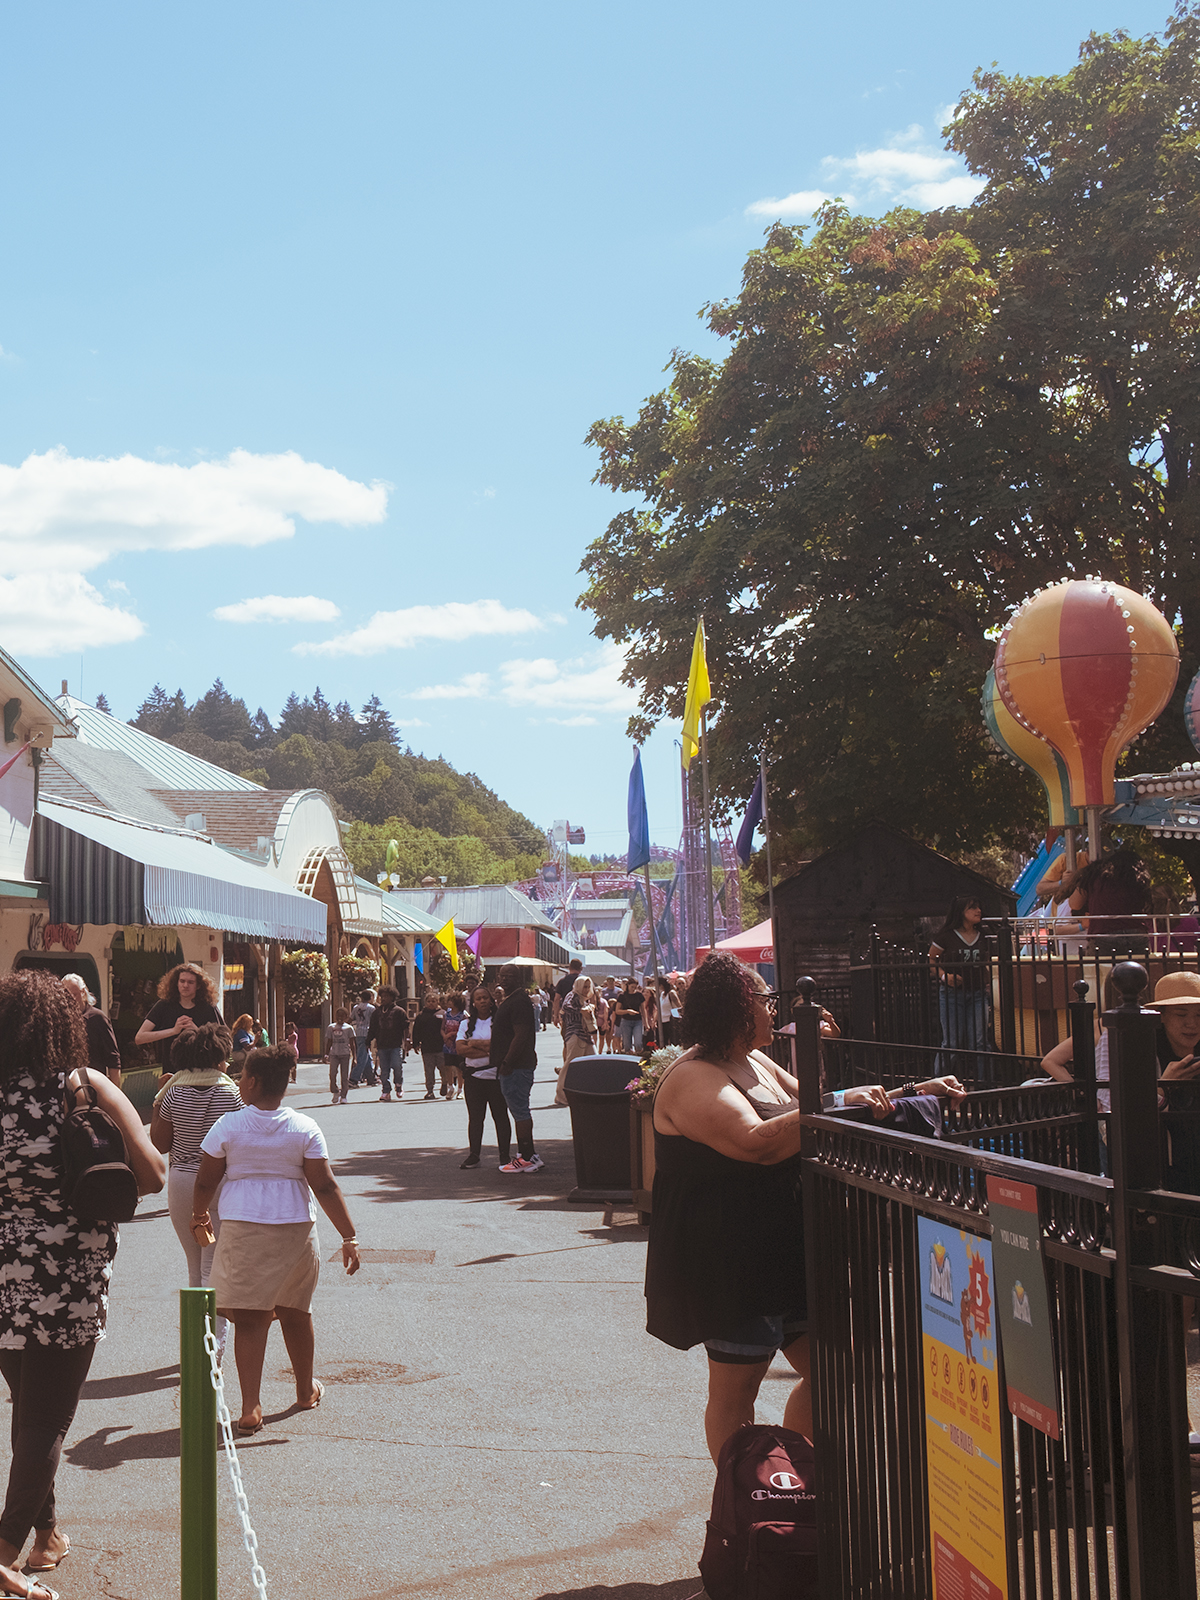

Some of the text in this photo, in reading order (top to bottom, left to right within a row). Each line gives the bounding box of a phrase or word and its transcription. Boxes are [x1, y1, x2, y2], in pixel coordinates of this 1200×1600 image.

[1000, 1229, 1030, 1251] YOU CAN RIDE
[975, 1272, 984, 1307] 5
[950, 1423, 960, 1447] RIDE
